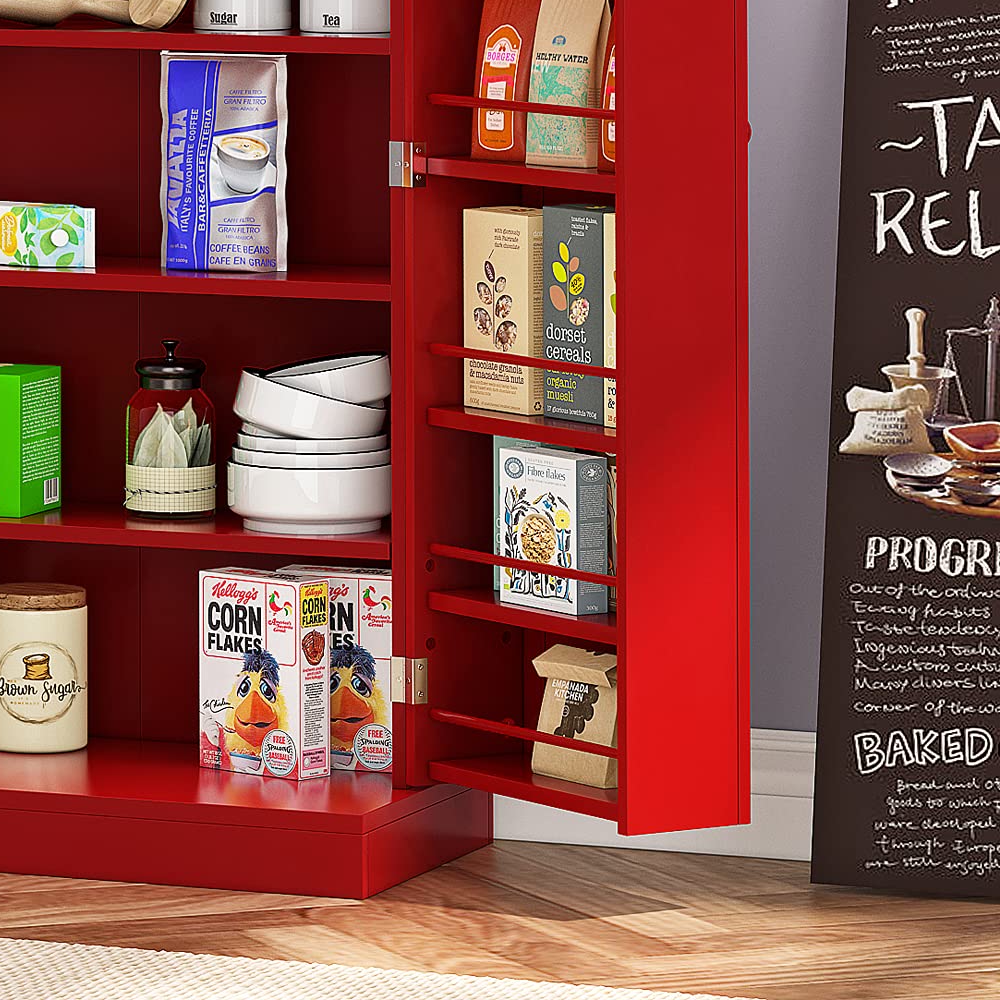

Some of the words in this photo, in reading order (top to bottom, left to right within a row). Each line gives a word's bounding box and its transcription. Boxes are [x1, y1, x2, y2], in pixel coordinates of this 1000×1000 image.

[210, 12, 238, 25] Sugar
[322, 14, 340, 27] Tea
[486, 52, 516, 62] BORGES
[563, 53, 589, 64] WATER
[189, 107, 199, 141] COFFEE
[184, 141, 196, 195] FAVOURITE
[197, 108, 213, 232] BAR&CAFFETTERIA
[180, 196, 192, 233] ITALY'S
[209, 243, 242, 254] COFFEE
[243, 245, 270, 255] BEANS
[209, 255, 231, 265] CAFE
[235, 257, 246, 265] EN
[249, 257, 276, 267] GRAINS
[546, 323, 587, 344] dorset
[546, 345, 592, 364] cereals
[469, 359, 498, 372] chocolate
[499, 363, 523, 376] granola
[476, 371, 510, 382] macadamia
[511, 373, 525, 384] nuts
[546, 376, 577, 390] organic
[546, 390, 574, 403] muesli
[527, 465, 545, 478] Fibre
[545, 468, 566, 482] flakes
[212, 581, 259, 604] Kellogg's
[849, 583, 885, 595] Out
[884, 583, 907, 599] of
[906, 583, 944, 598] the
[302, 596, 327, 615] CORN
[207, 601, 262, 636] CORN
[302, 613, 327, 626] FLAKES
[207, 632, 263, 655] FLAKES
[853, 637, 947, 662] Ingenious
[41, 680, 77, 703] Sugar
[552, 679, 589, 694] EMPANADA
[853, 678, 909, 692] Many
[554, 689, 584, 702] KITCHEN
[924, 699, 946, 717] of
[272, 735, 286, 745] FREE
[367, 729, 383, 738] FREE
[363, 746, 389, 755] BASEBALL
[854, 728, 994, 774] BAKED
